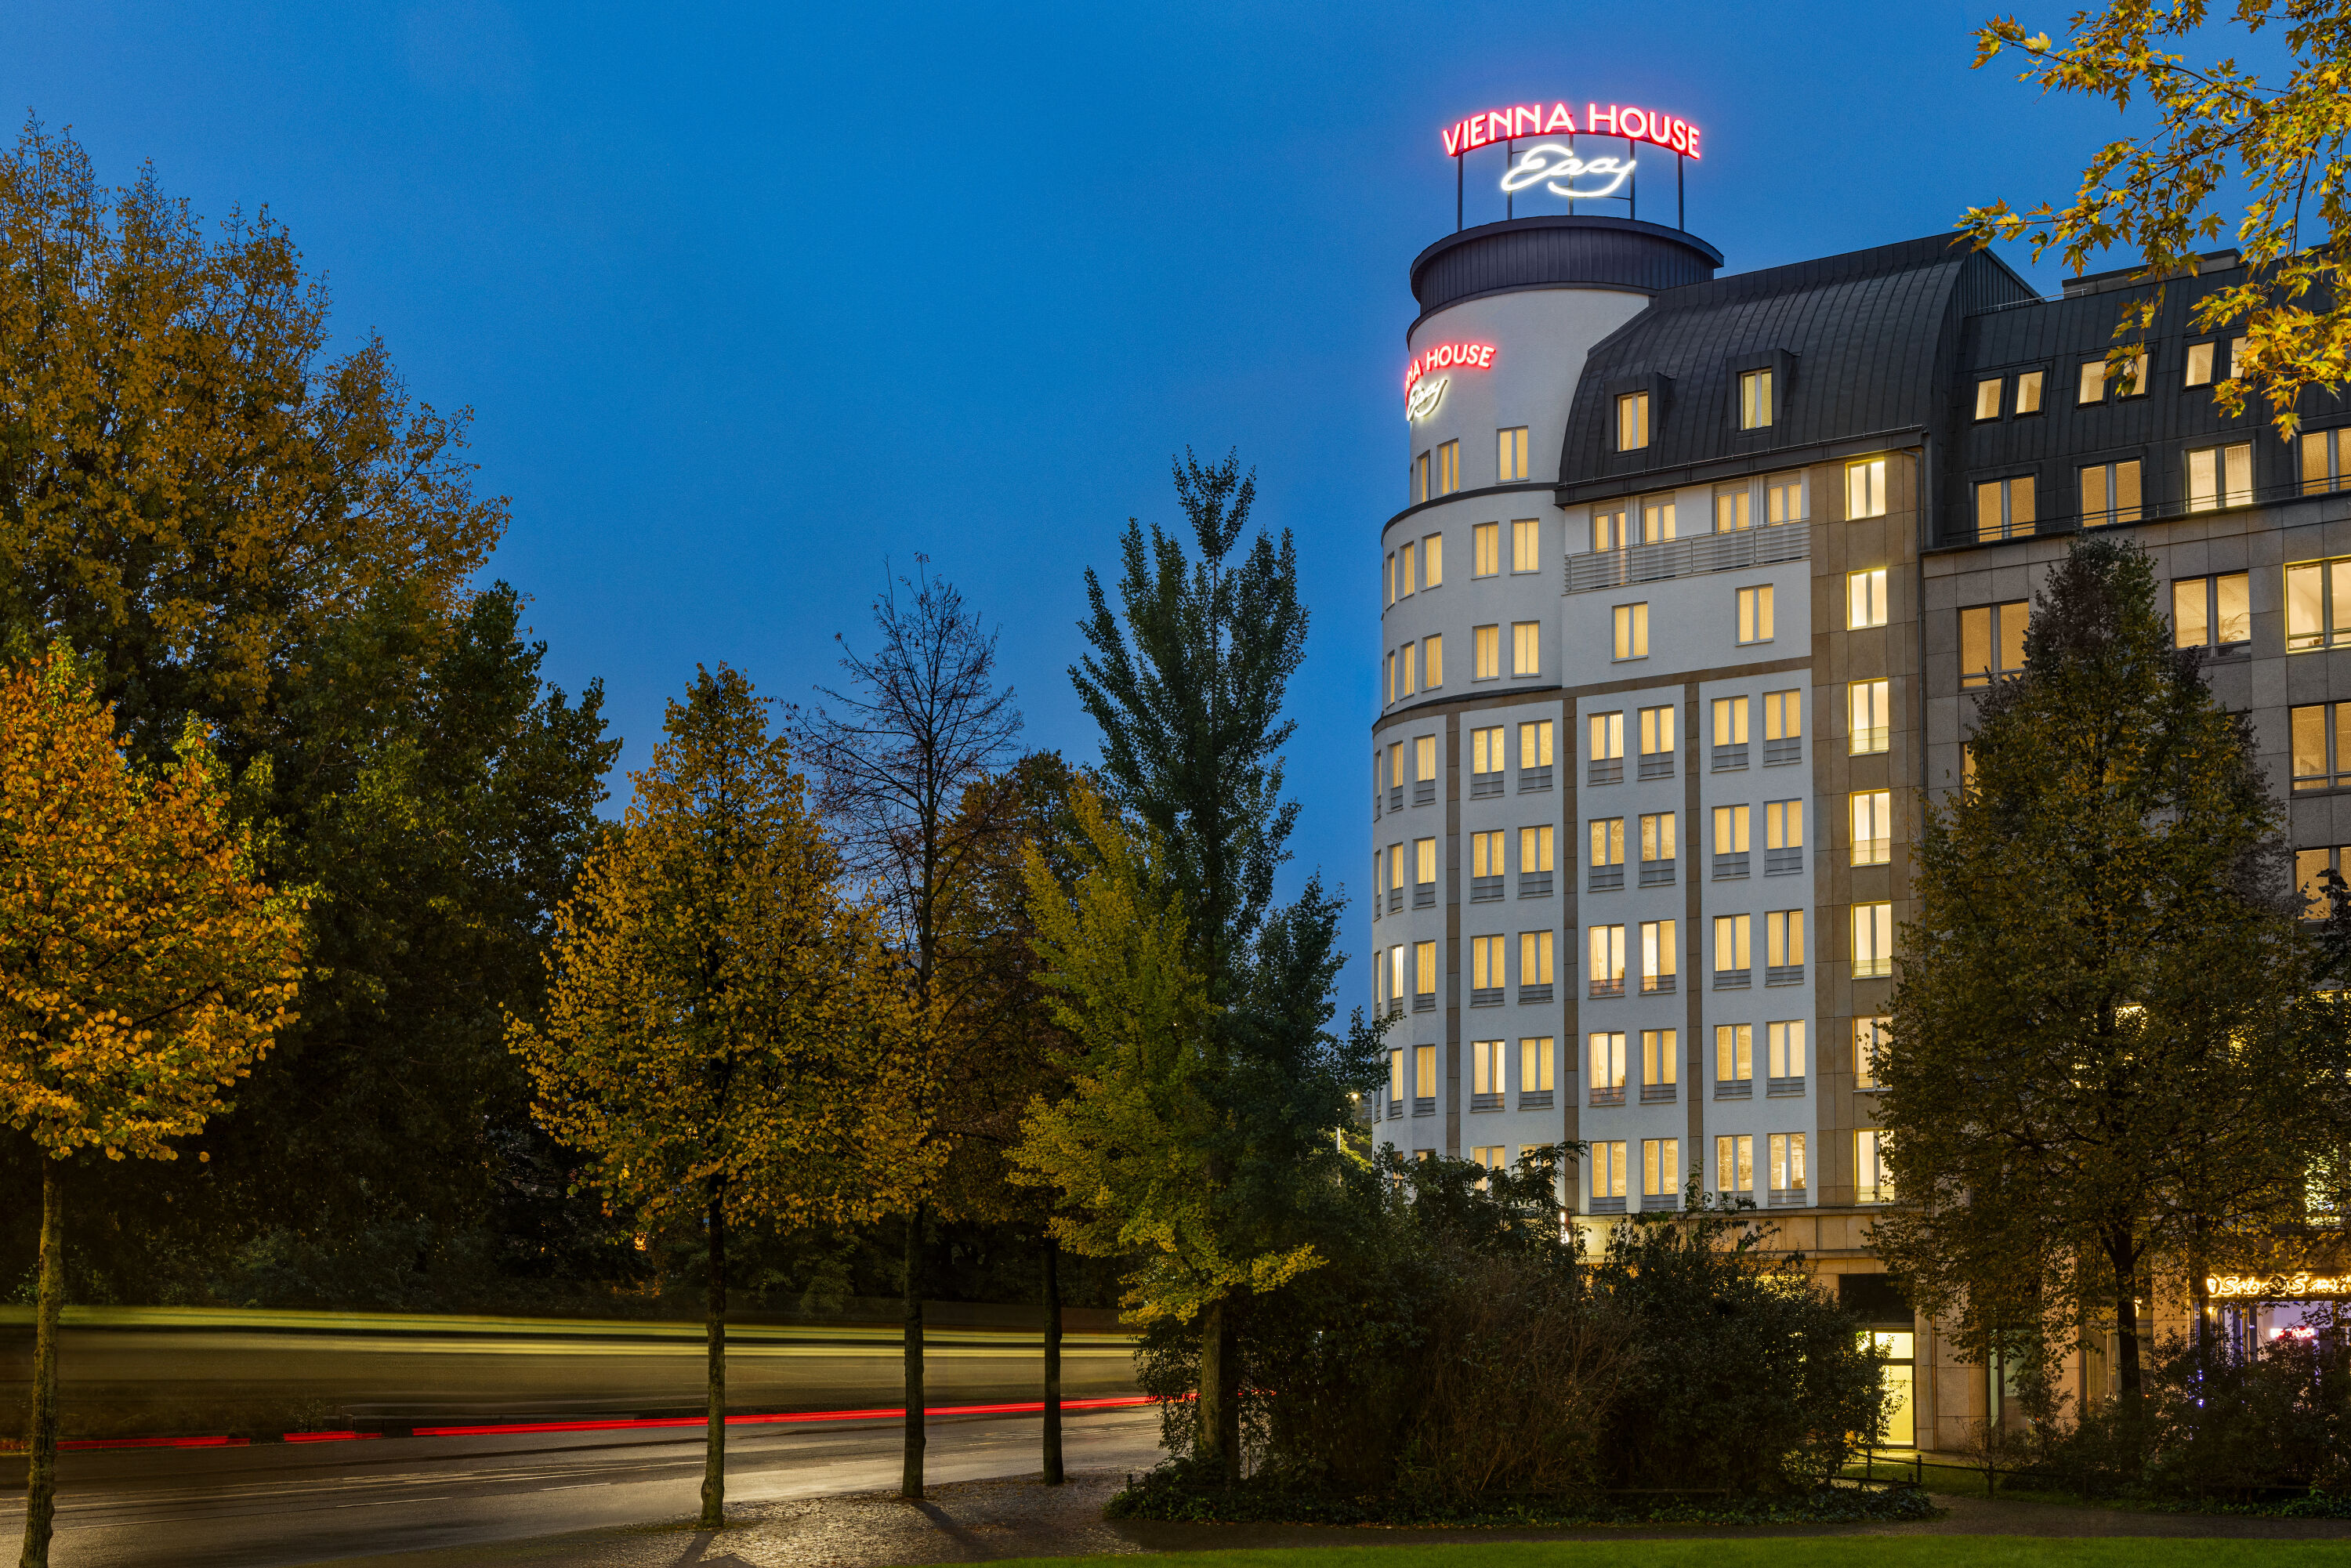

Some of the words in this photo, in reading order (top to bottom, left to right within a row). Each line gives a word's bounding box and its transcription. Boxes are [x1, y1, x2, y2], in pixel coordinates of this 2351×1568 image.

[1443, 103, 1576, 157] VIENNA
[1588, 103, 1701, 160] HOUSE
[1501, 143, 1637, 197] Easy
[1426, 344, 1495, 371] HOUSE
